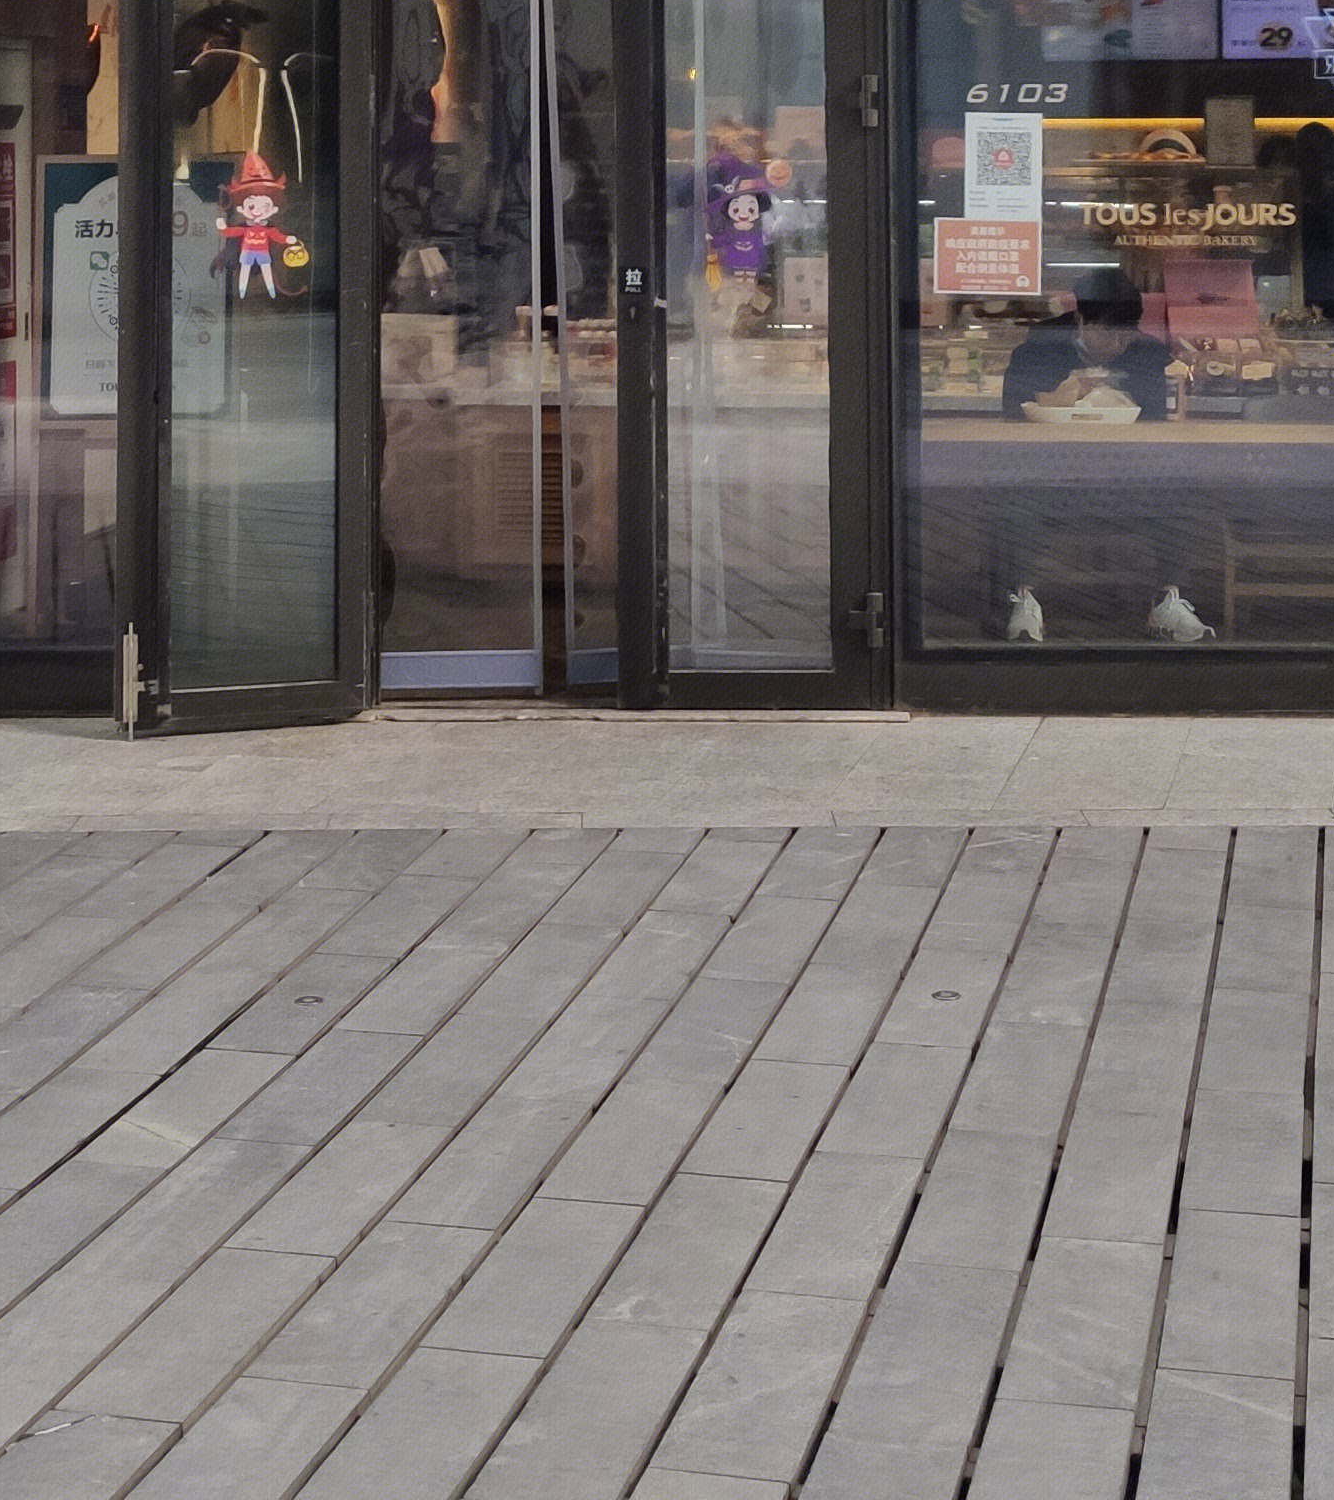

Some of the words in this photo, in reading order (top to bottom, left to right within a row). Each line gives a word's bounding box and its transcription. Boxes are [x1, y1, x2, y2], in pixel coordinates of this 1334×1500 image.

[1260, 27, 1293, 47] 29
[966, 83, 1068, 103] 6103
[1082, 203, 1157, 226] TOUS
[1164, 204, 1200, 226] les
[1200, 203, 1296, 230] JOURS
[626, 268, 643, 286] 拉
